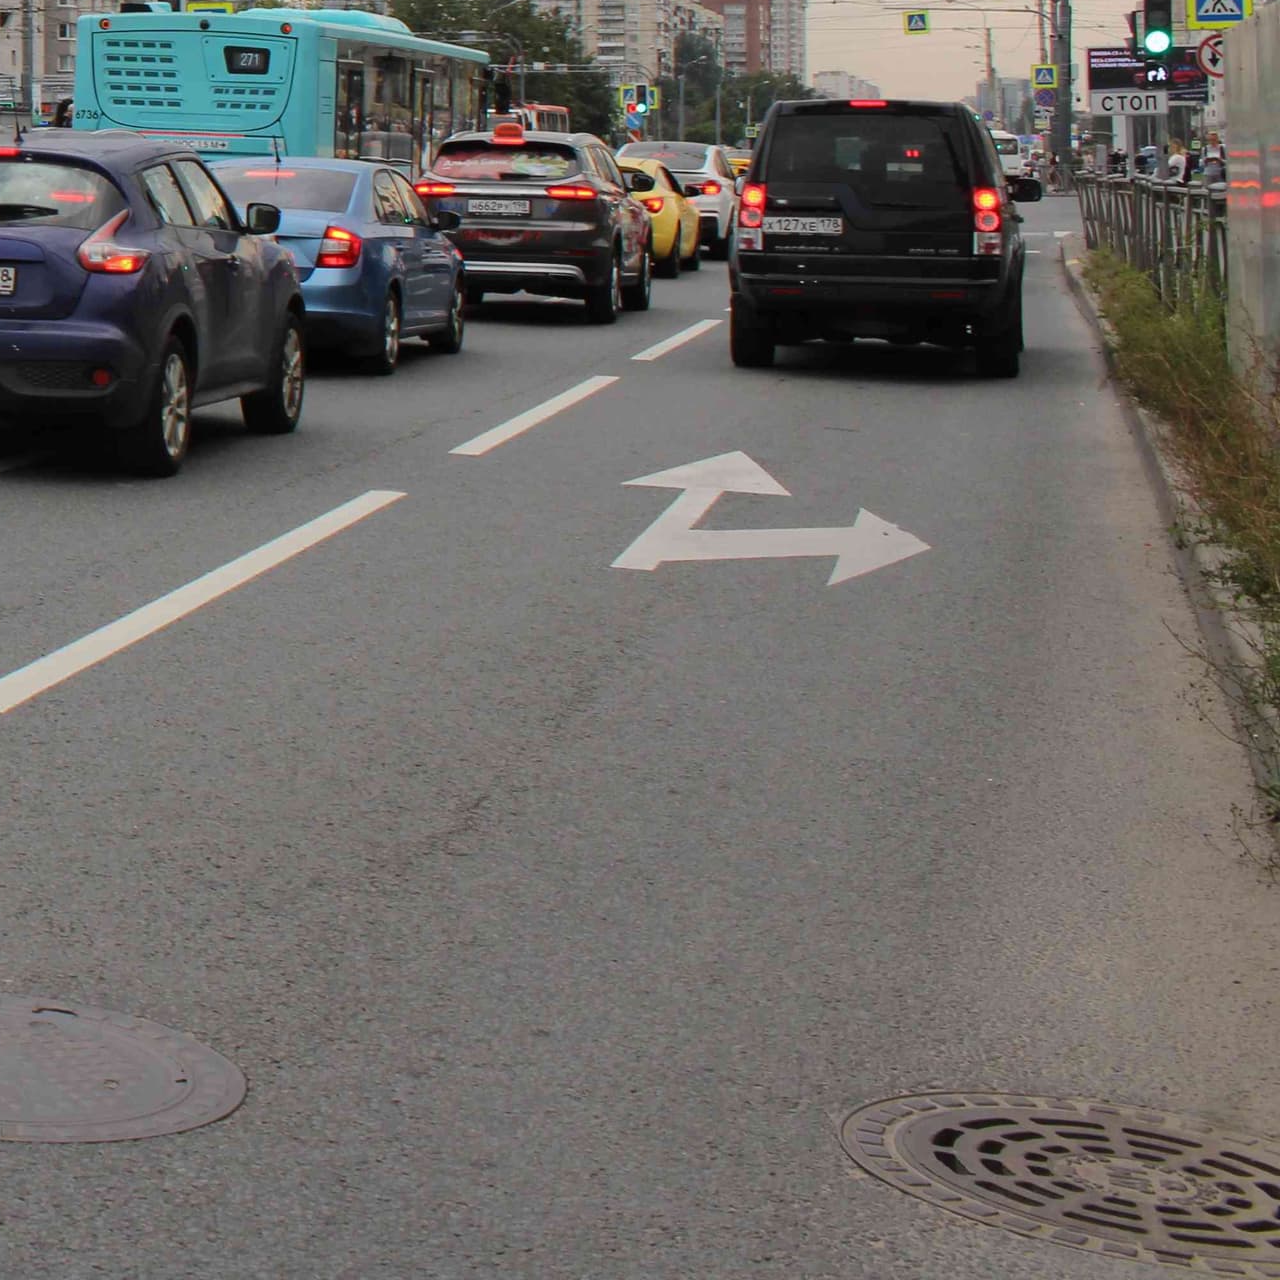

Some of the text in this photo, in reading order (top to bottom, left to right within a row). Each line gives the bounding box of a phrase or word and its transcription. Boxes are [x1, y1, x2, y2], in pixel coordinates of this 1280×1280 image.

[240, 53, 259, 66] 271
[1101, 95, 1157, 111] СТОП
[75, 110, 99, 120] 6736
[767, 219, 817, 231] Х127ХЕ
